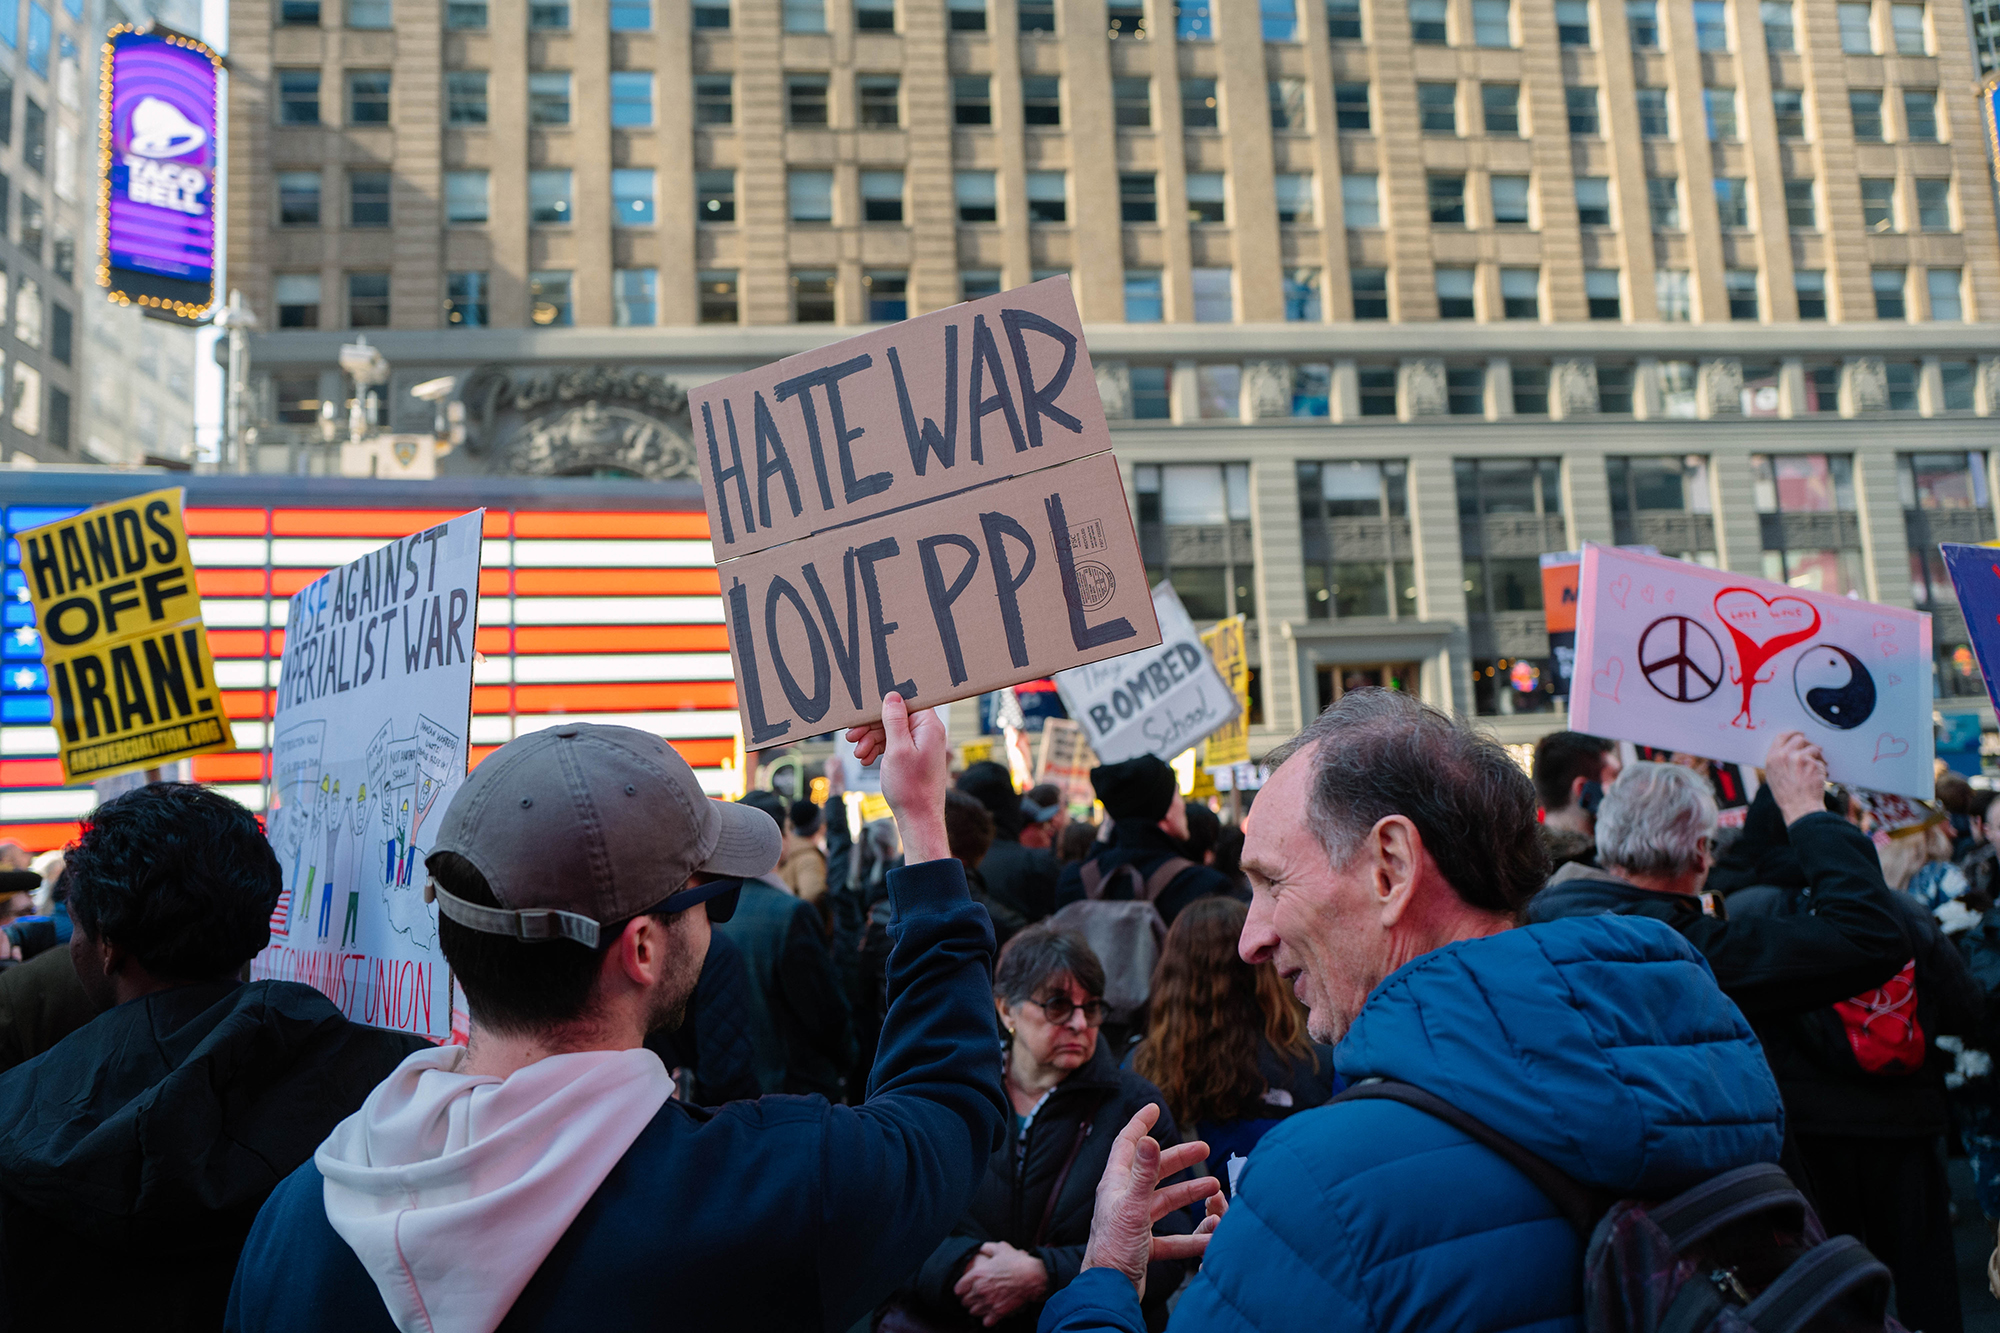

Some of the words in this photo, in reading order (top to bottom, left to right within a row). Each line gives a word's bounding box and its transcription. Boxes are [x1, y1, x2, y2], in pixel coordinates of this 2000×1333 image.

[122, 154, 207, 194] TACO
[127, 181, 206, 215] BELL
[701, 353, 894, 544] HATE
[887, 309, 1083, 476] WAR
[28, 501, 179, 599] HANDS
[331, 524, 449, 627] AGAINST
[44, 567, 189, 646] OFF
[403, 588, 469, 675] WAR
[728, 537, 917, 744] LOVE
[917, 493, 1137, 687] PPL
[54, 629, 214, 742] IRAN!
[1088, 641, 1202, 736] BOMBED
[1141, 685, 1217, 753] School
[363, 956, 432, 1034] UNION
